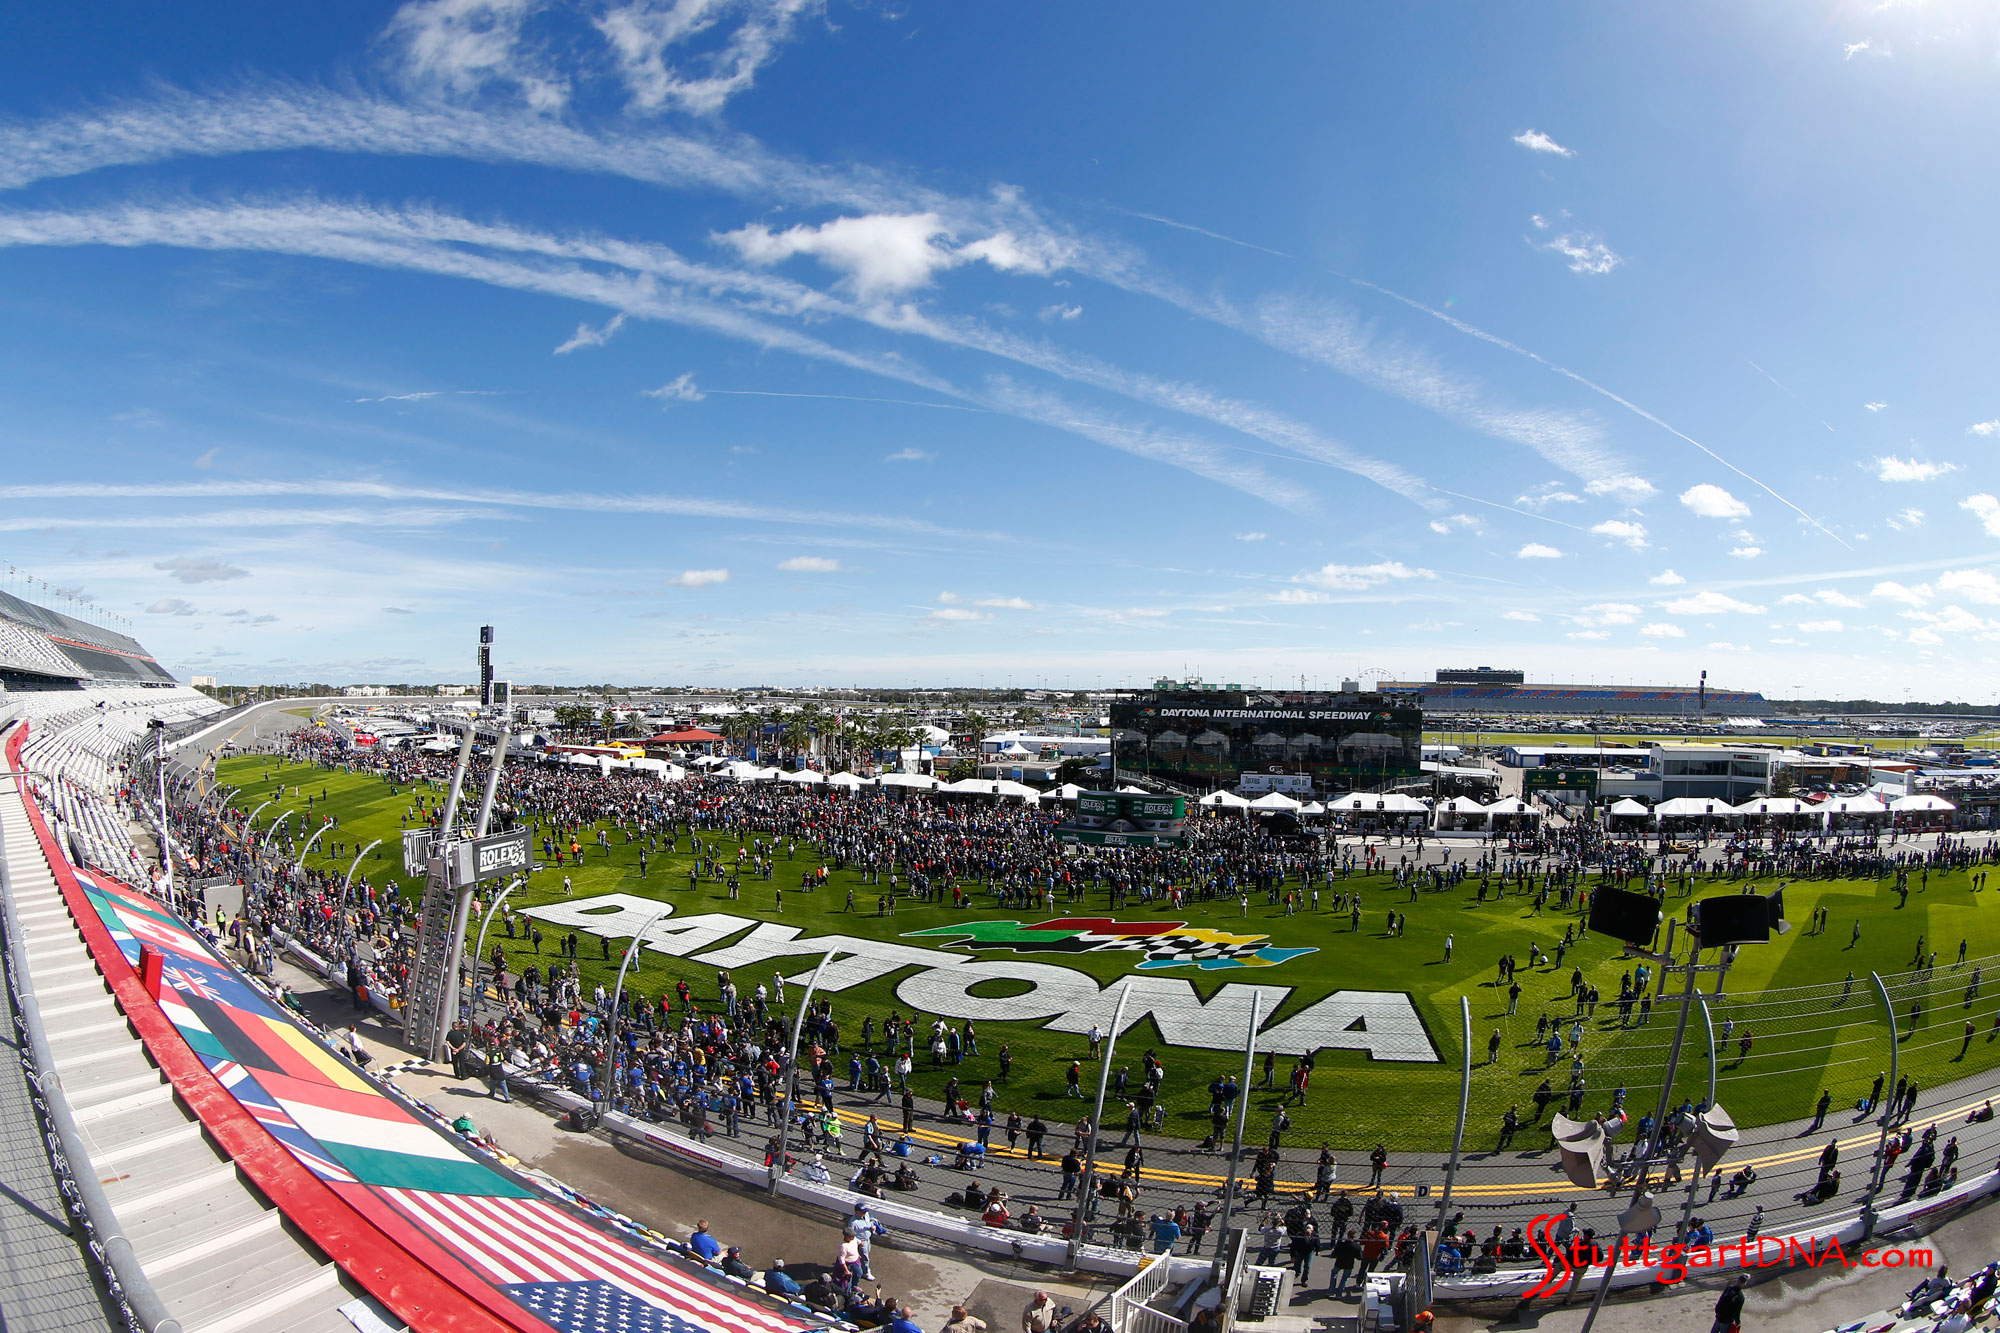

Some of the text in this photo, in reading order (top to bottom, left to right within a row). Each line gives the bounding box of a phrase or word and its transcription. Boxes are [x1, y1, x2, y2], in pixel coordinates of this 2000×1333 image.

[1160, 708, 1371, 720] DAYTONA INTERNATIONAL SPEEDWAY
[1144, 804, 1165, 812] ROLEX
[480, 846, 514, 867] ROLEX
[510, 850, 526, 867] 24
[509, 892, 1447, 1065] DAYTONA
[1418, 1185, 1428, 1197] D
